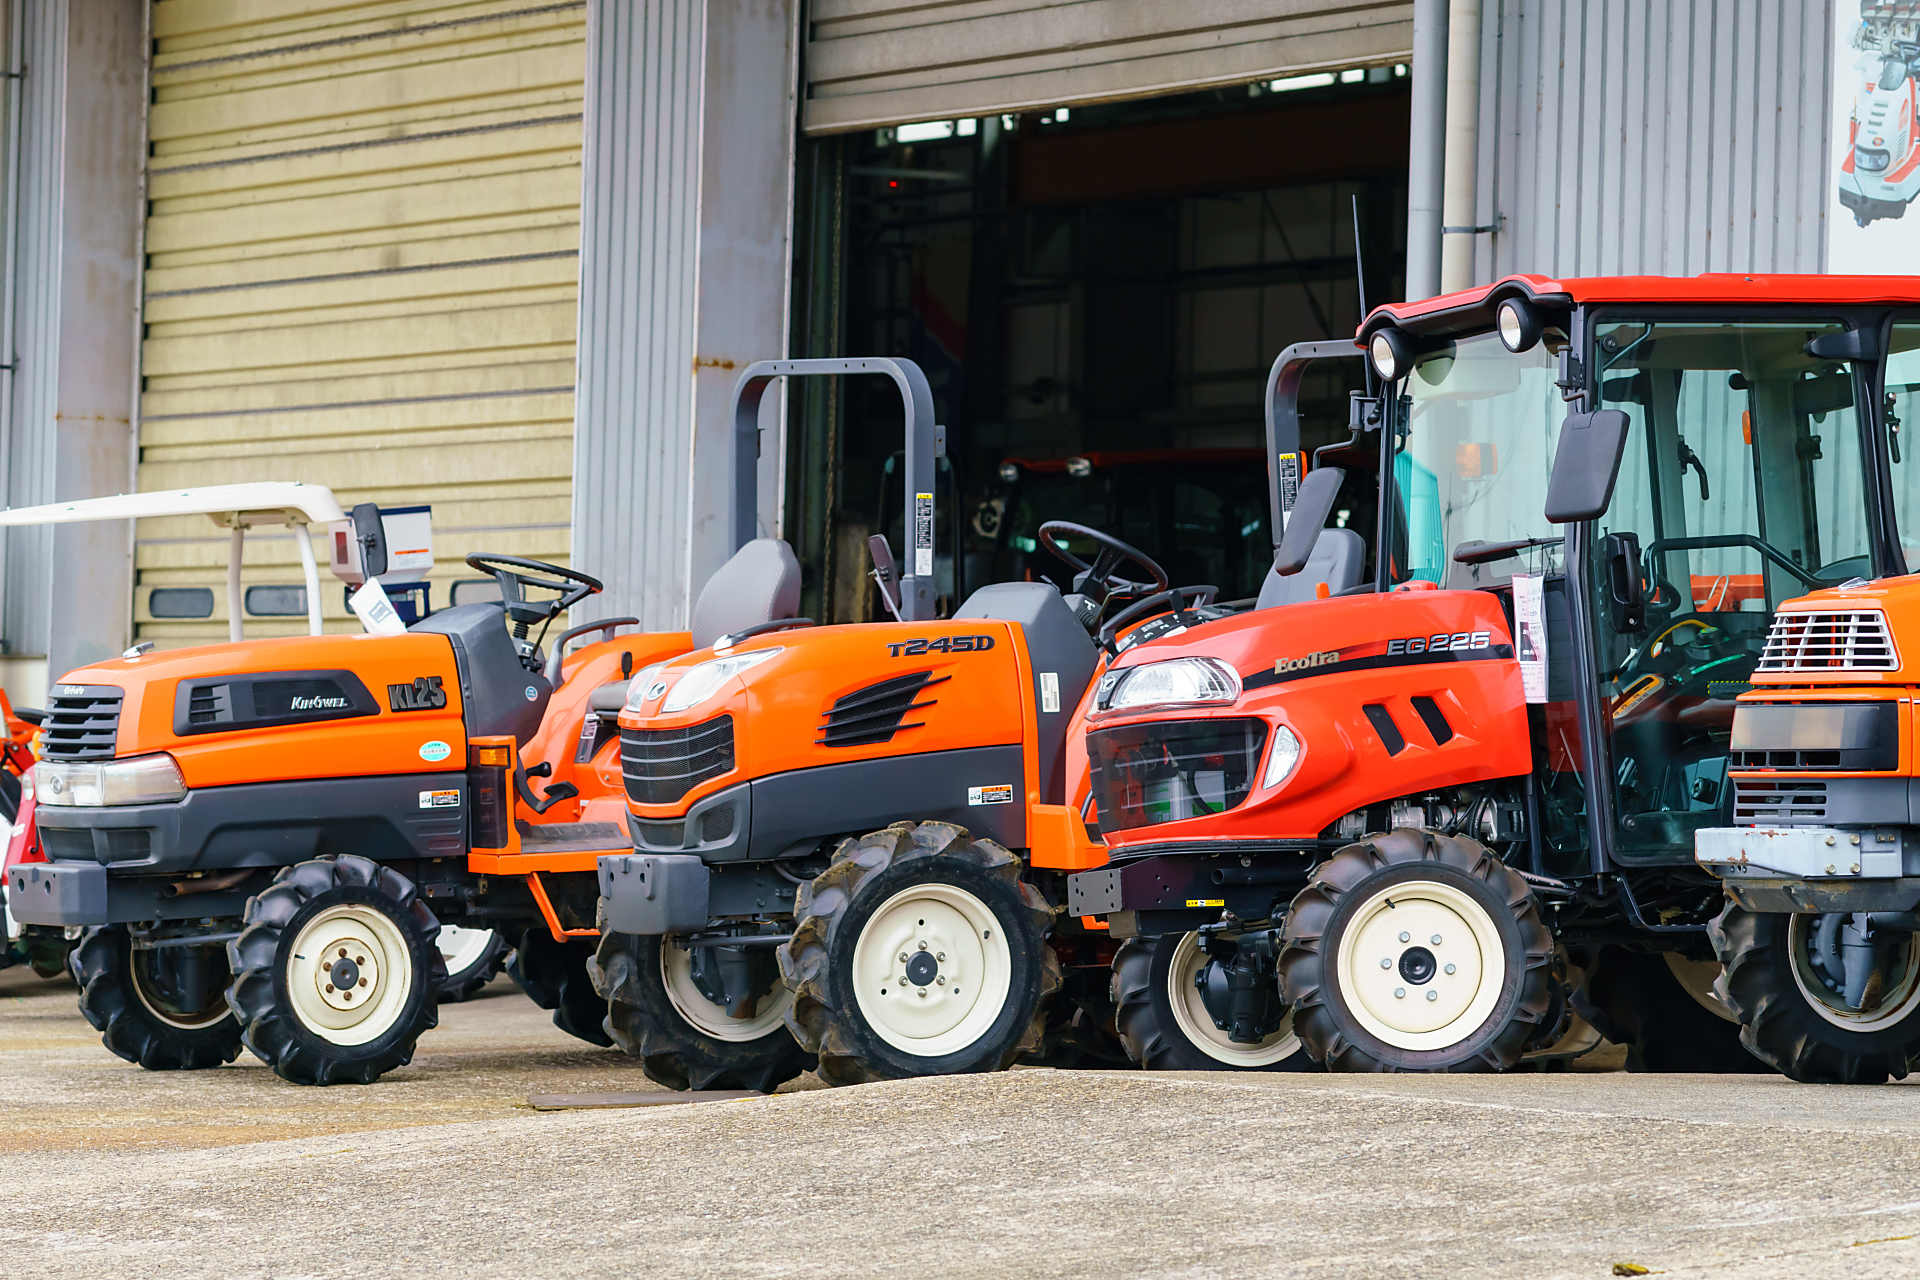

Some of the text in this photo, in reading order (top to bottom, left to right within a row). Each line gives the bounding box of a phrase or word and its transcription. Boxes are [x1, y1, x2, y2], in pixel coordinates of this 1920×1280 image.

[887, 635, 995, 657] T245D
[1273, 651, 1341, 675] EcoTra
[387, 676, 447, 713] KL25
